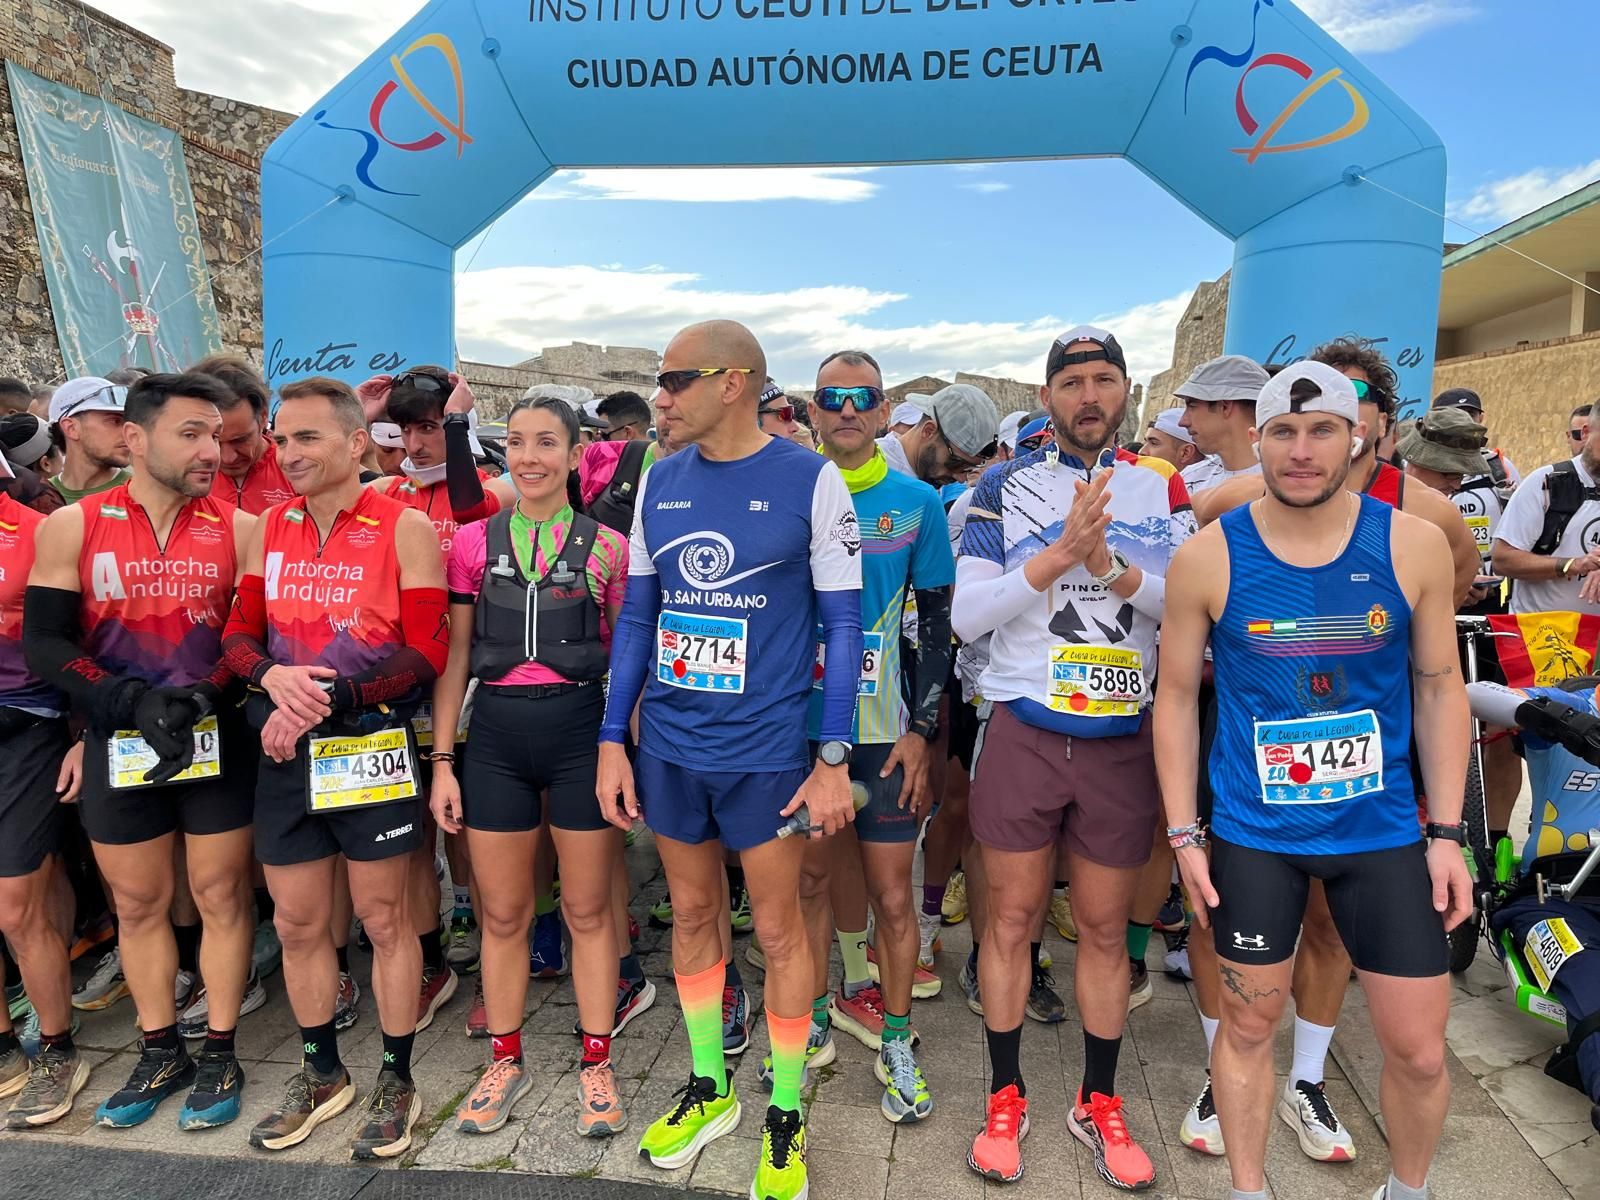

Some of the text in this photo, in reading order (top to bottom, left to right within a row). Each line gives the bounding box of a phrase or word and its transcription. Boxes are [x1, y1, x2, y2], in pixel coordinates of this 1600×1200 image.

[567, 42, 1104, 89] CIUDAD AUTÓNOMA DE CEUTA
[268, 338, 407, 380] Ceuta es
[1396, 346, 1425, 368] es
[656, 500, 691, 510] BALEARIA
[1460, 503, 1477, 513] ND
[674, 589, 701, 606] SAN
[704, 591, 768, 609] URBANO
[680, 635, 737, 665] 2714
[1089, 666, 1142, 695] 5898
[351, 750, 407, 779] 4304
[1302, 735, 1371, 771] 1427
[386, 823, 413, 840] TERREX
[1539, 935, 1563, 971] 4609
